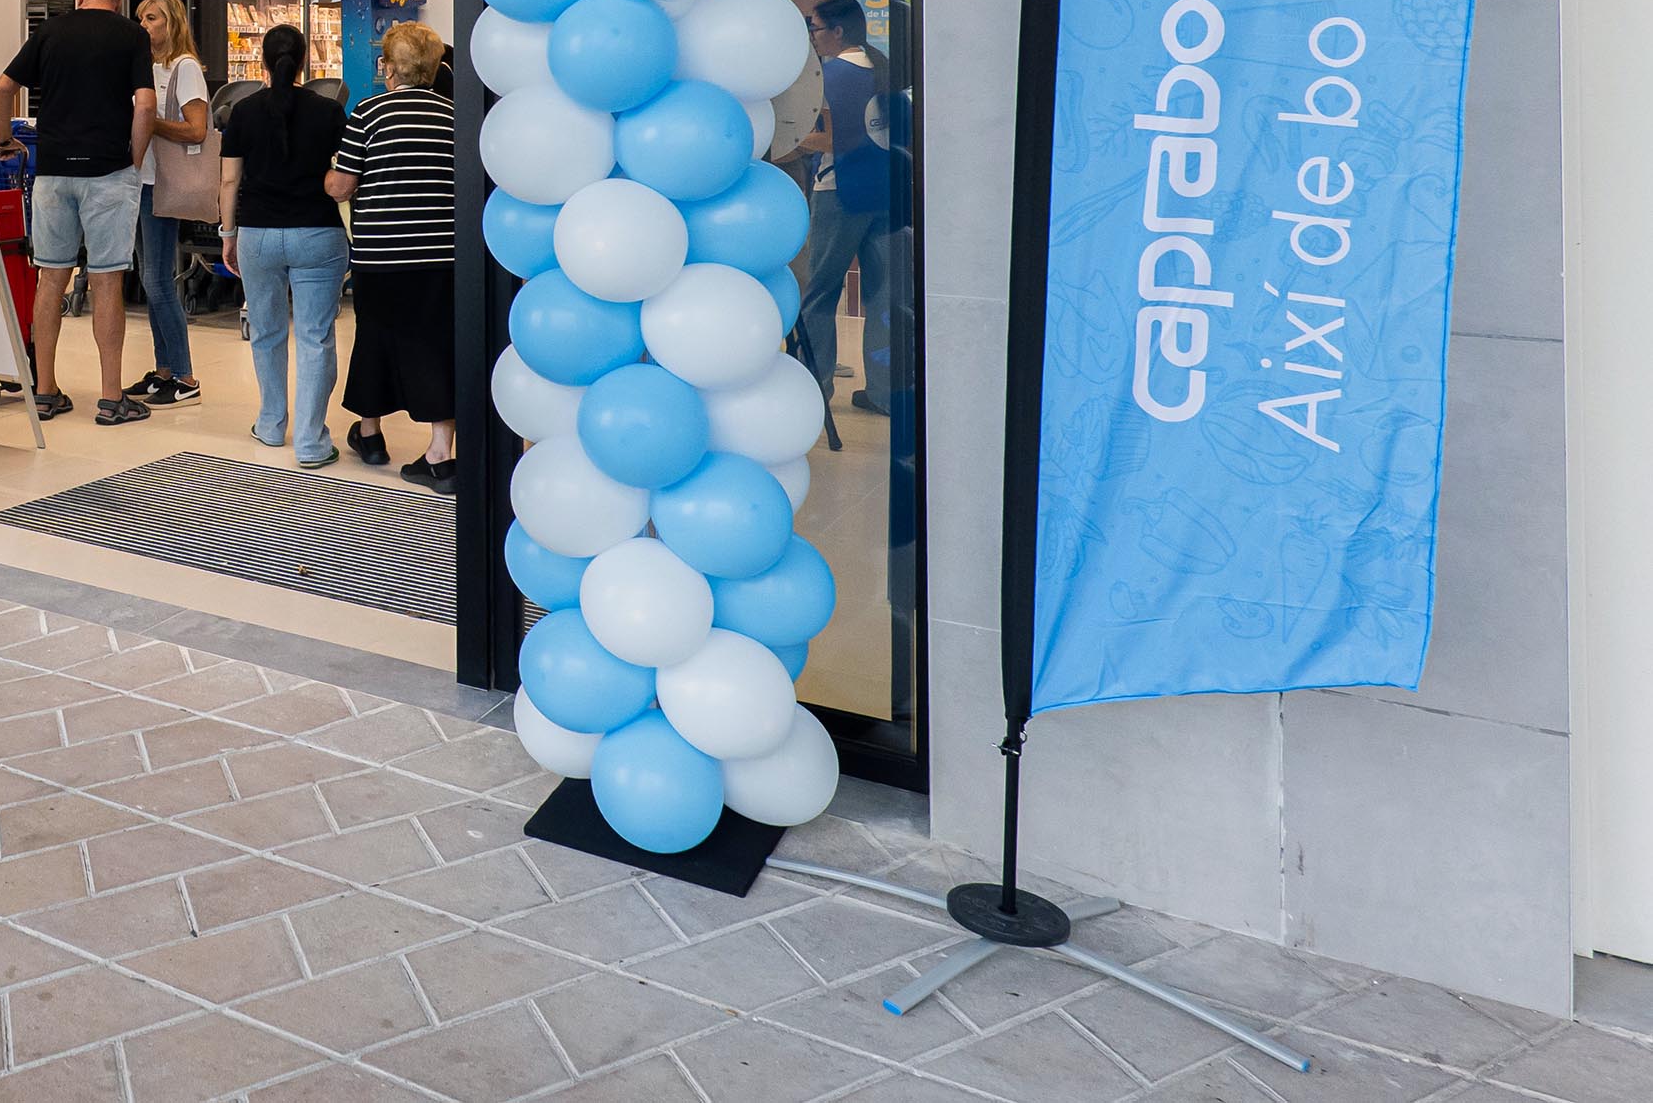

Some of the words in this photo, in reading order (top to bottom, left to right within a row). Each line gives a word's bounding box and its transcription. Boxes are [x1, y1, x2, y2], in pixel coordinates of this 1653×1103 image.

[866, 10, 878, 18] de
[1277, 16, 1366, 128] bo
[1271, 155, 1354, 267] de
[1257, 281, 1346, 453] Així
